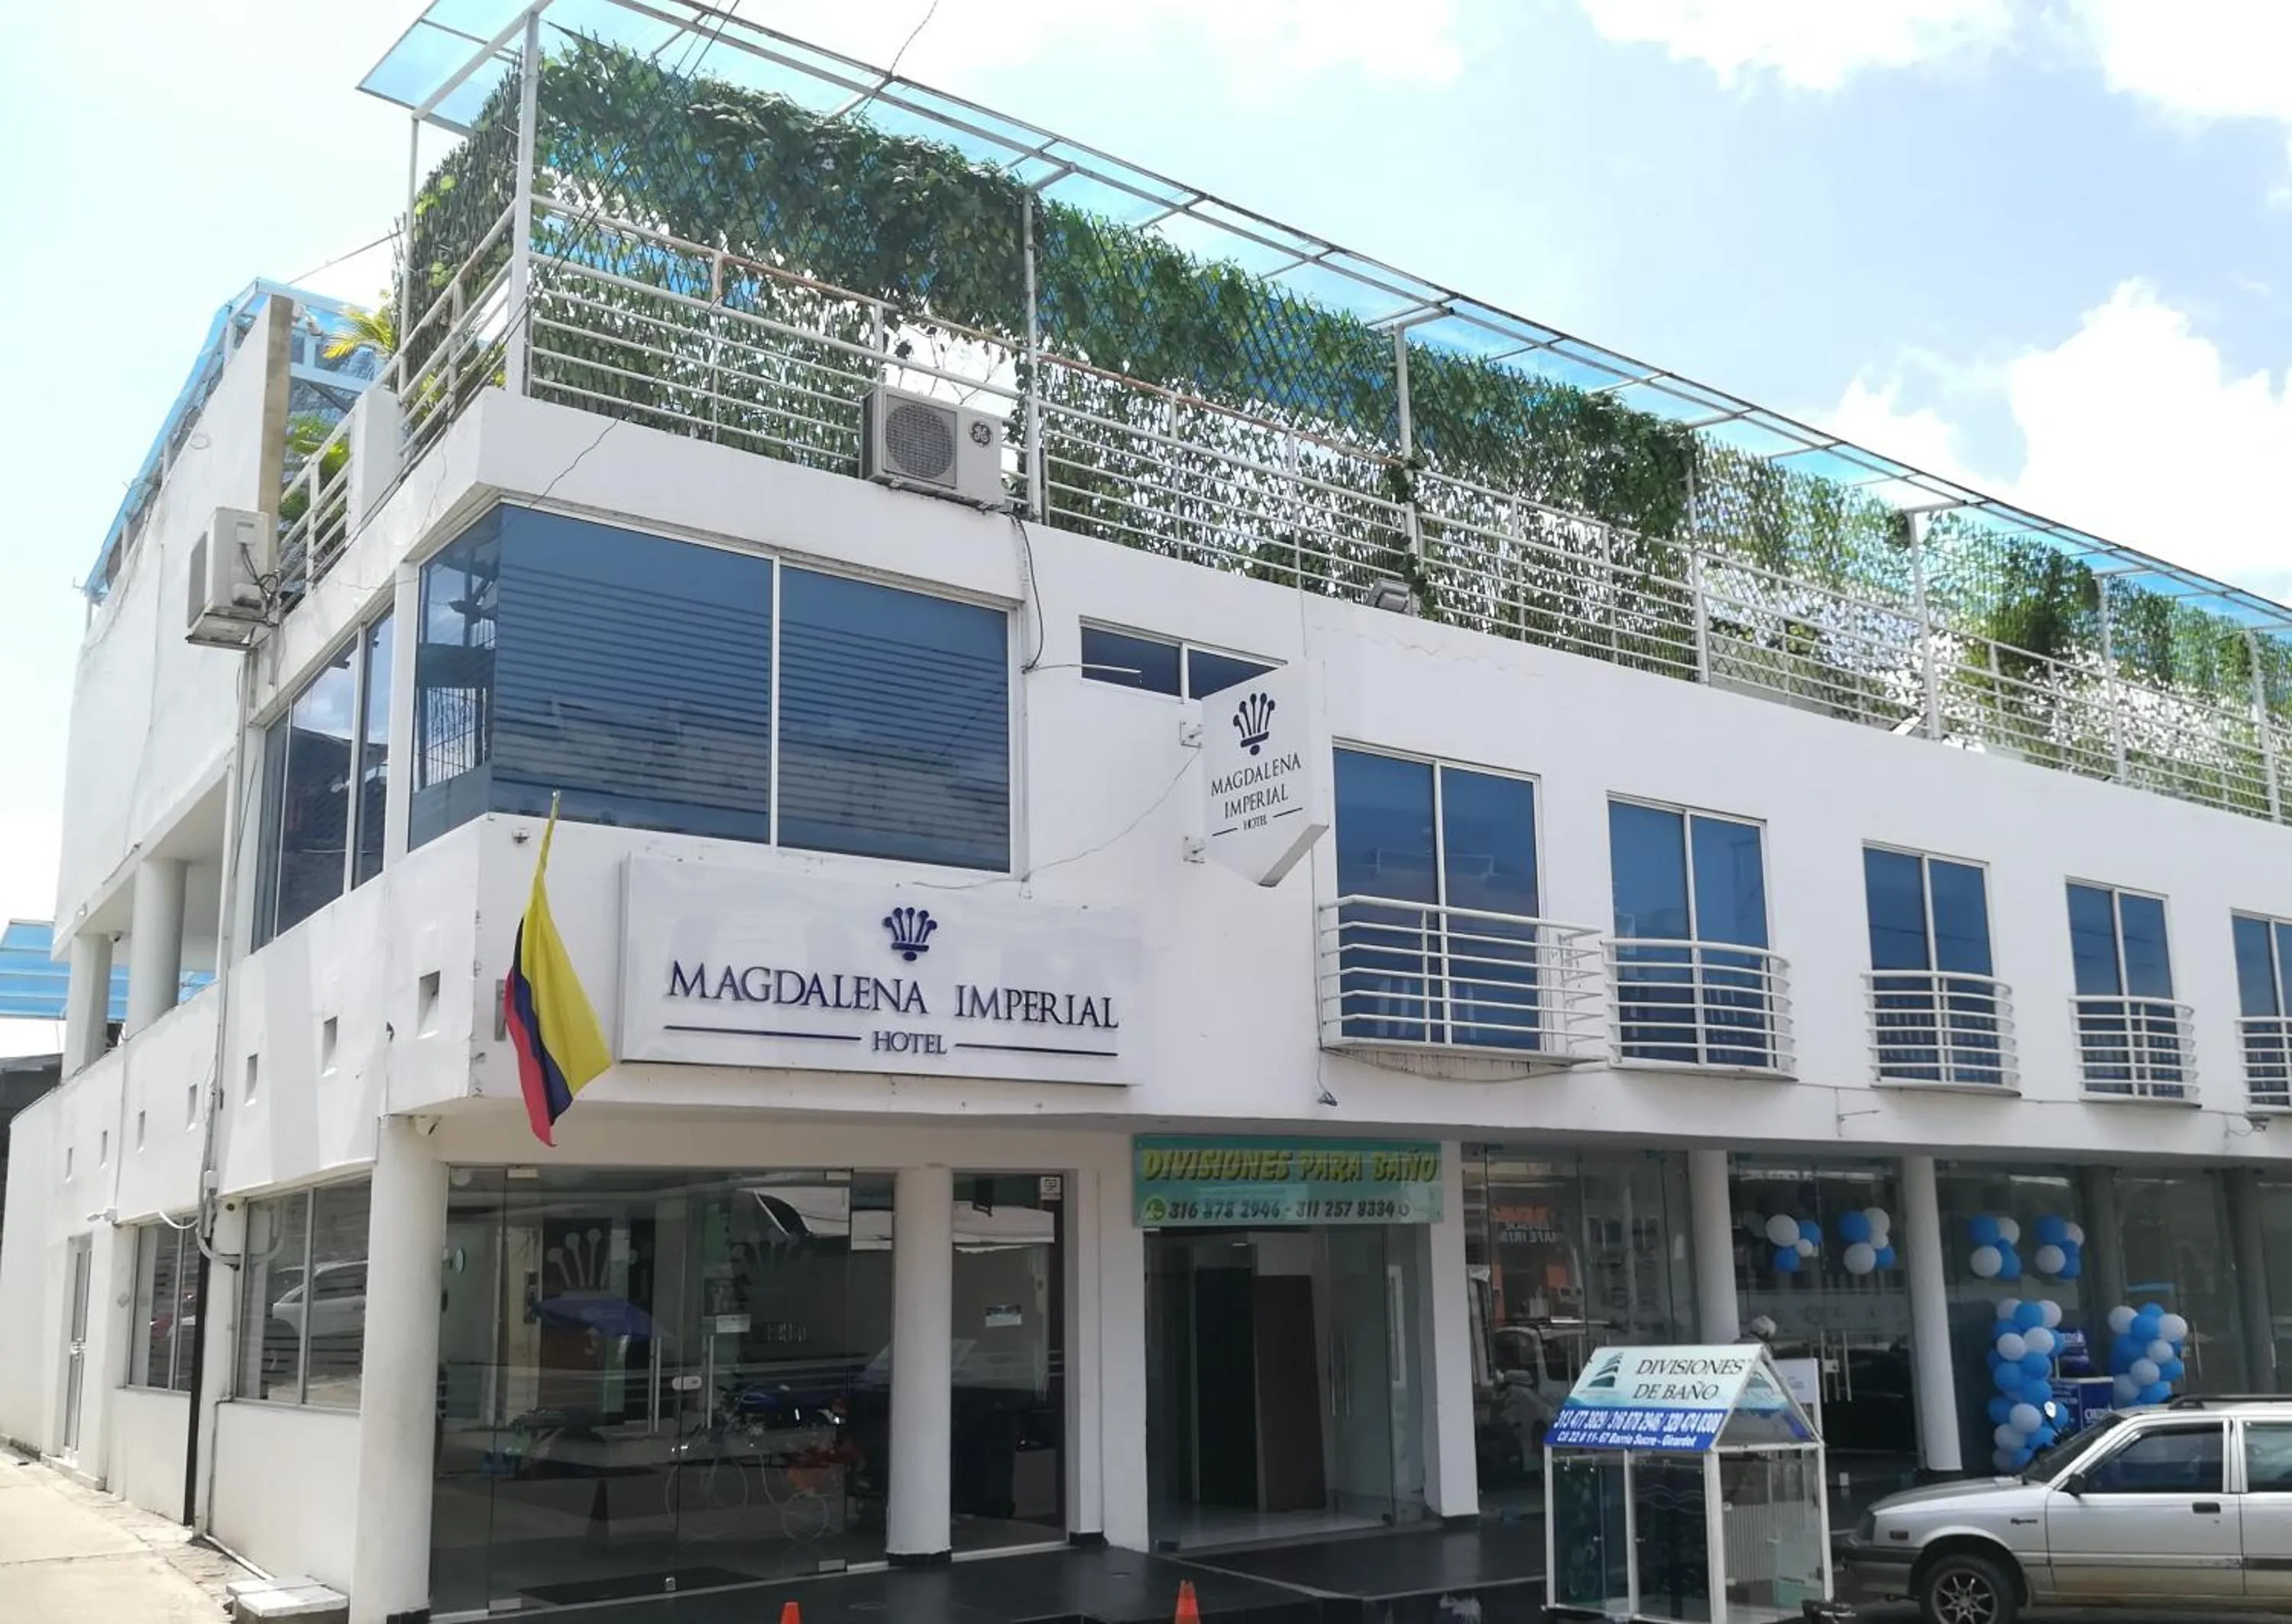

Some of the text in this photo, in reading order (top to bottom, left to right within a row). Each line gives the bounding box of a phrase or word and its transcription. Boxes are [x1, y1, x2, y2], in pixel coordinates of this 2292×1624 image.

[1211, 752, 1302, 797] MAGDALENA
[1224, 784, 1288, 819] IMPERIAL
[1243, 815, 1268, 832] HOTEL
[668, 959, 1119, 1028] MAGDALENA IMPERIAL
[872, 1030, 948, 1055] HOTEL
[1143, 1148, 1437, 1183] DIVISIONES PARA BAÑO
[1169, 1202, 1198, 1219] 316
[1324, 1199, 1353, 1218] 257
[1636, 1358, 1743, 1375] DIVISIONES
[1633, 1381, 1719, 1400] DE BAÑO
